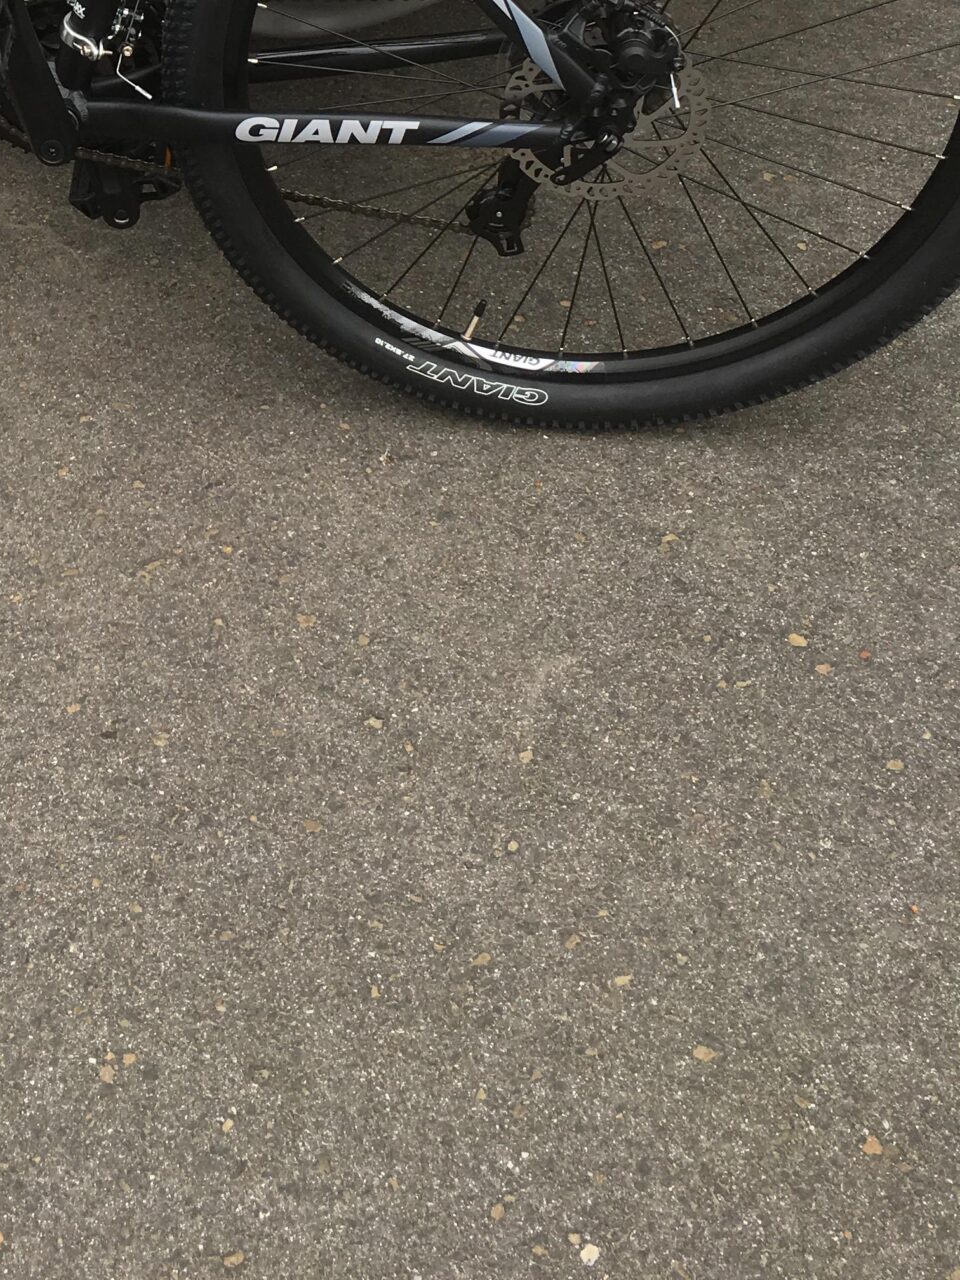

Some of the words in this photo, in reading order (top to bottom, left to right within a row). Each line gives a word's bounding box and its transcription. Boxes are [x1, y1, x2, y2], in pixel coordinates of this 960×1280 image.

[235, 117, 420, 144] GIANT
[492, 349, 541, 366] GIANT
[406, 361, 549, 406] GIANT
